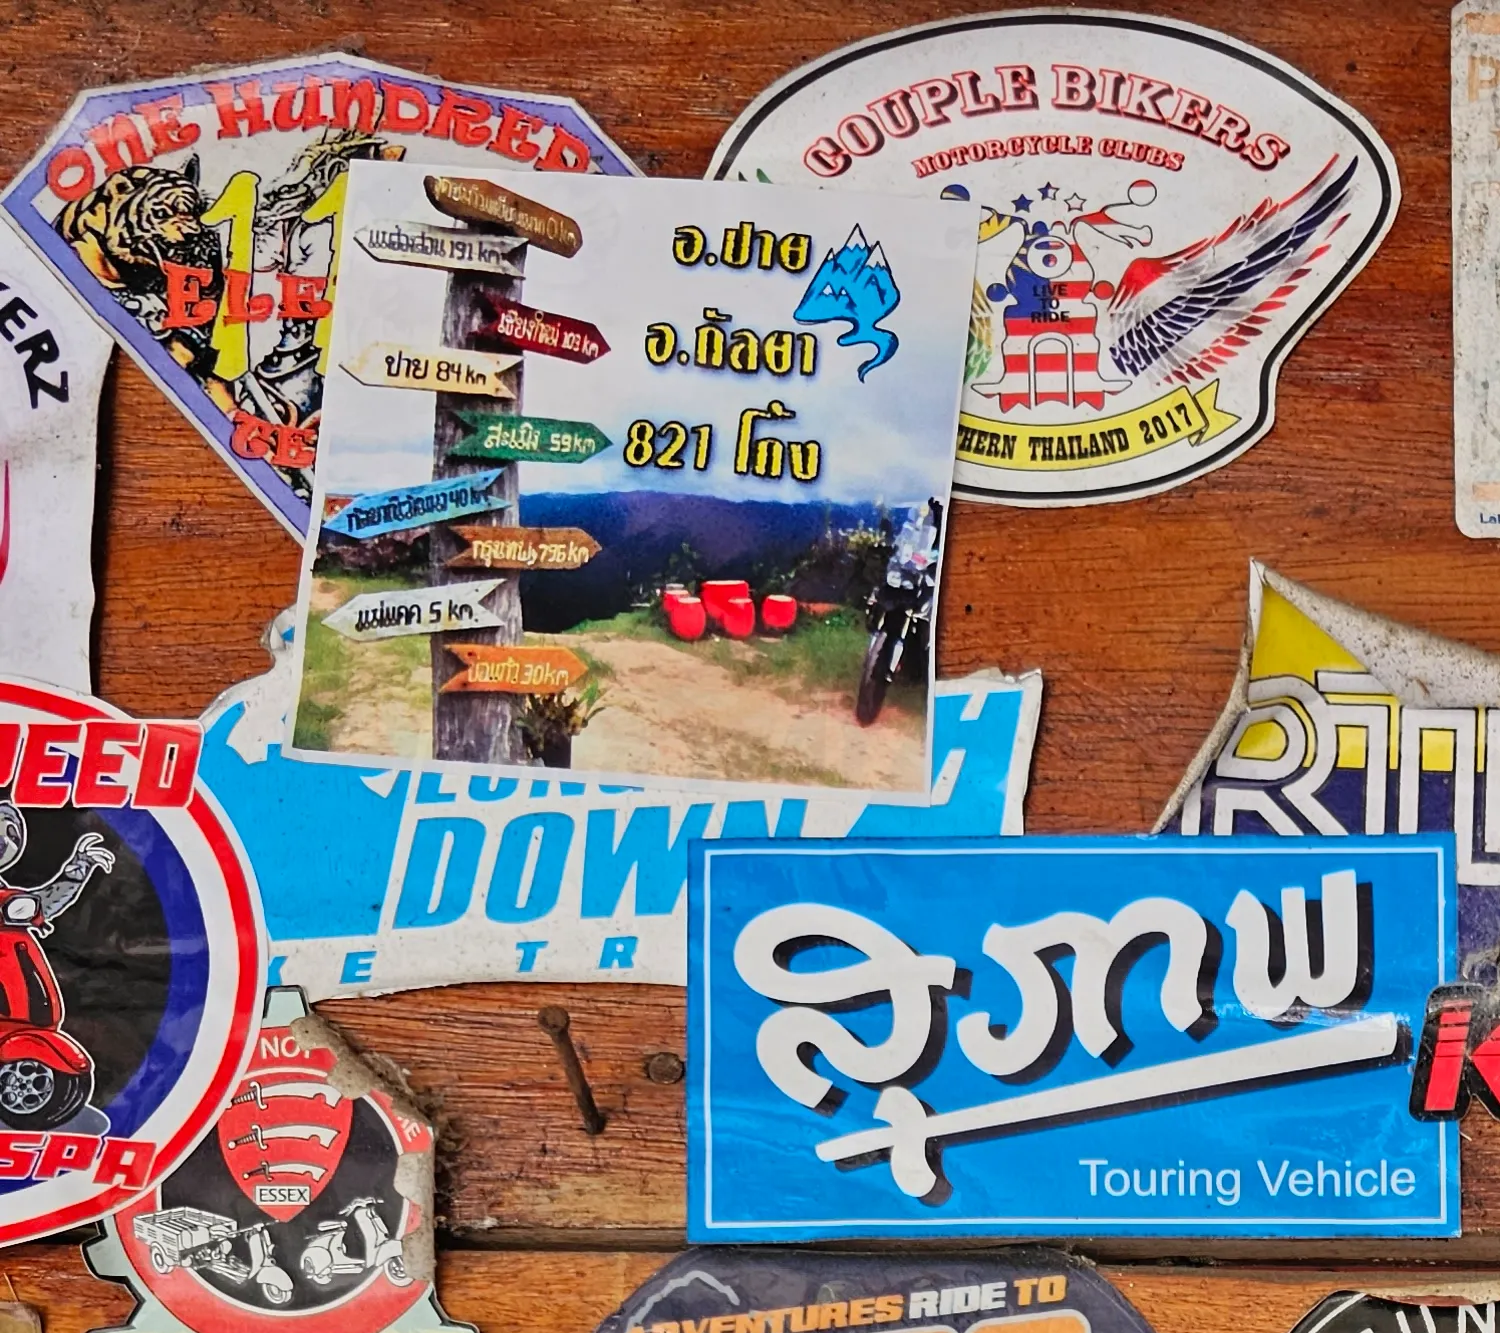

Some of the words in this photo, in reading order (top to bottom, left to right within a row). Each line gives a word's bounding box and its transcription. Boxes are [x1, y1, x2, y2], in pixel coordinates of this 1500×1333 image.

[46, 94, 202, 202] ONE
[216, 77, 594, 174] HUNDRED
[802, 62, 1039, 179] COUPLE
[1050, 63, 1291, 172] BIKERS
[913, 134, 1094, 178] MOTORCYCLE
[1098, 136, 1185, 172] CLUBS
[449, 239, 473, 261] 191
[477, 240, 501, 264] km
[672, 221, 812, 273] อ.ปาย
[1033, 284, 1069, 297] LIVE
[1040, 298, 1060, 310] TO
[1031, 311, 1071, 324] RIDE
[562, 329, 580, 350] 103
[580, 335, 599, 358] km
[385, 350, 429, 380] ปาย
[436, 361, 461, 383] 84
[465, 364, 487, 386] km
[623, 419, 714, 471] 821
[1028, 427, 1130, 462] THAILAND
[1138, 402, 1193, 444] 2017
[429, 602, 441, 624] 5
[259, 1189, 309, 1203] ESSEX
[1079, 1159, 1241, 1206] Touring
[1256, 1159, 1417, 1198] Vehicle
[908, 1282, 1007, 1319] RIDE
[1013, 1275, 1068, 1307] TO
